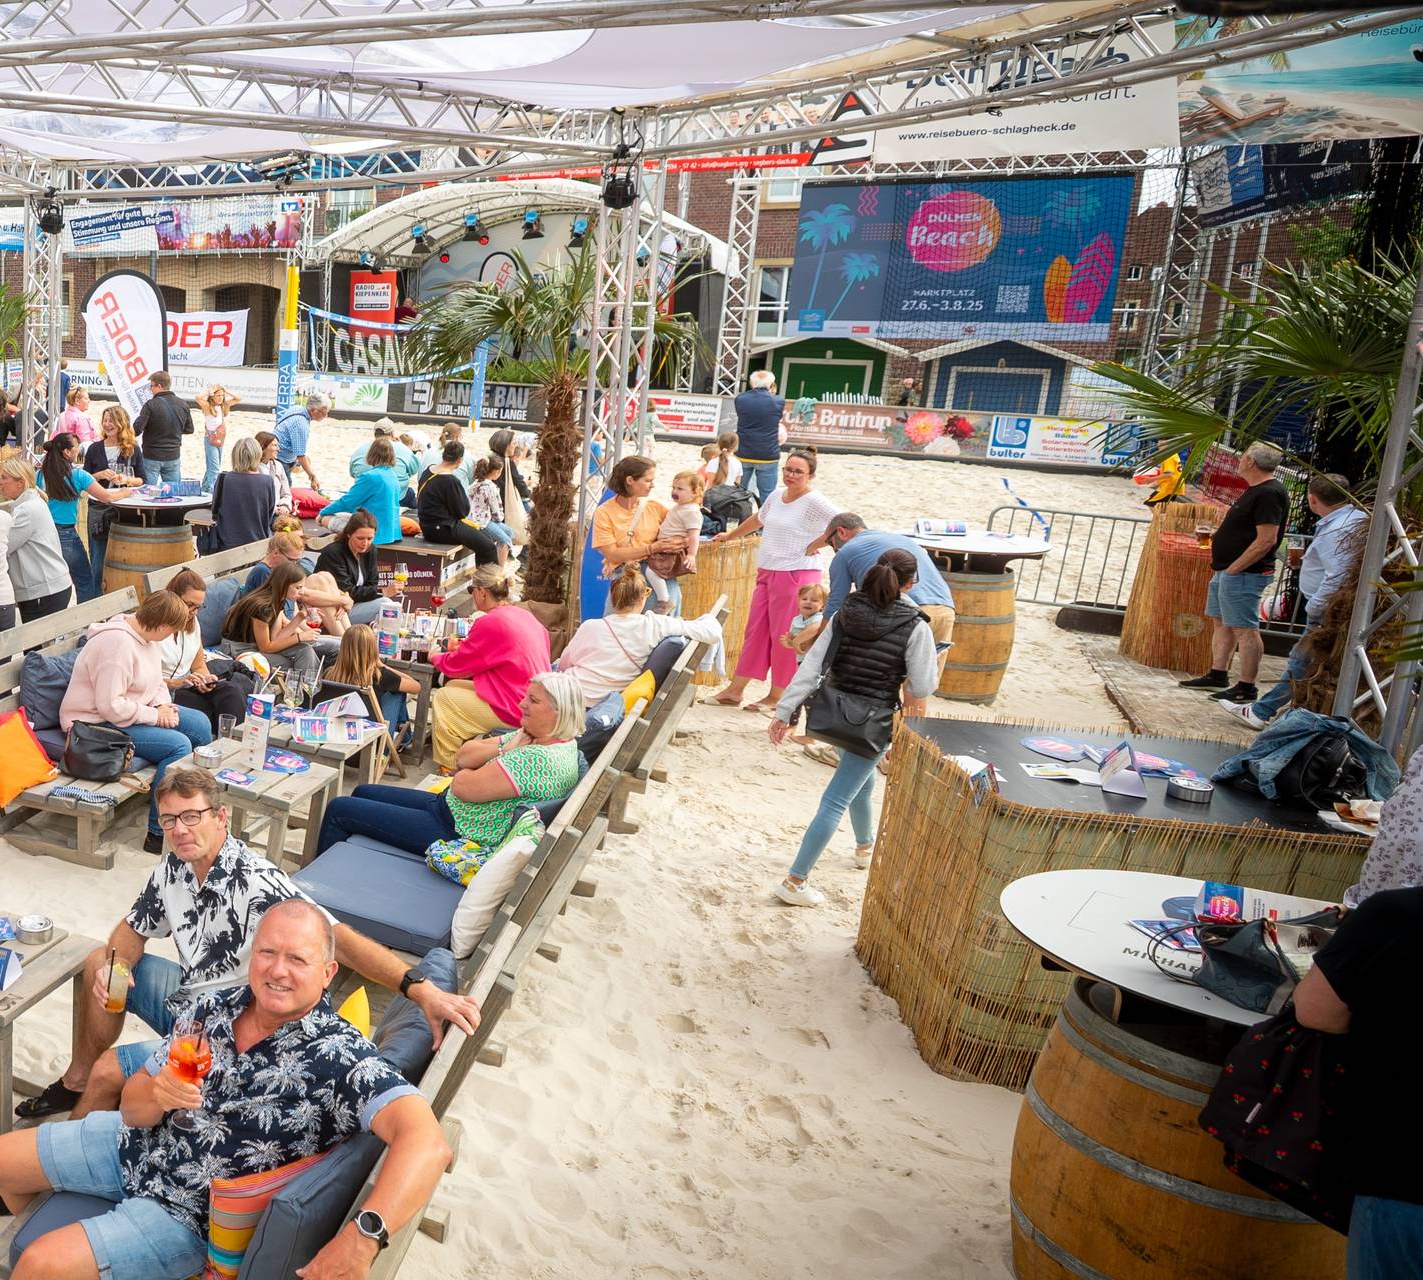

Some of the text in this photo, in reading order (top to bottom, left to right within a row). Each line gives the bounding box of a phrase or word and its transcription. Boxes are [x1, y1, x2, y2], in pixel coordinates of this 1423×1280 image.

[898, 122, 1077, 141] www.reisebuero-schlagheck.de
[70, 215, 113, 229] Engagement
[125, 209, 141, 220] gute
[72, 225, 107, 238] Stimmung
[107, 222, 121, 232] und
[121, 219, 145, 229] unsere
[145, 214, 174, 226] Region.
[928, 212, 982, 223] DÜLMEN
[910, 224, 994, 247] Beach
[913, 288, 976, 297] MARKTPLATZ
[71, 374, 102, 386] RNING
[494, 386, 530, 409] BAU
[500, 408, 527, 421] LANGE
[820, 408, 891, 432] Brintrup
